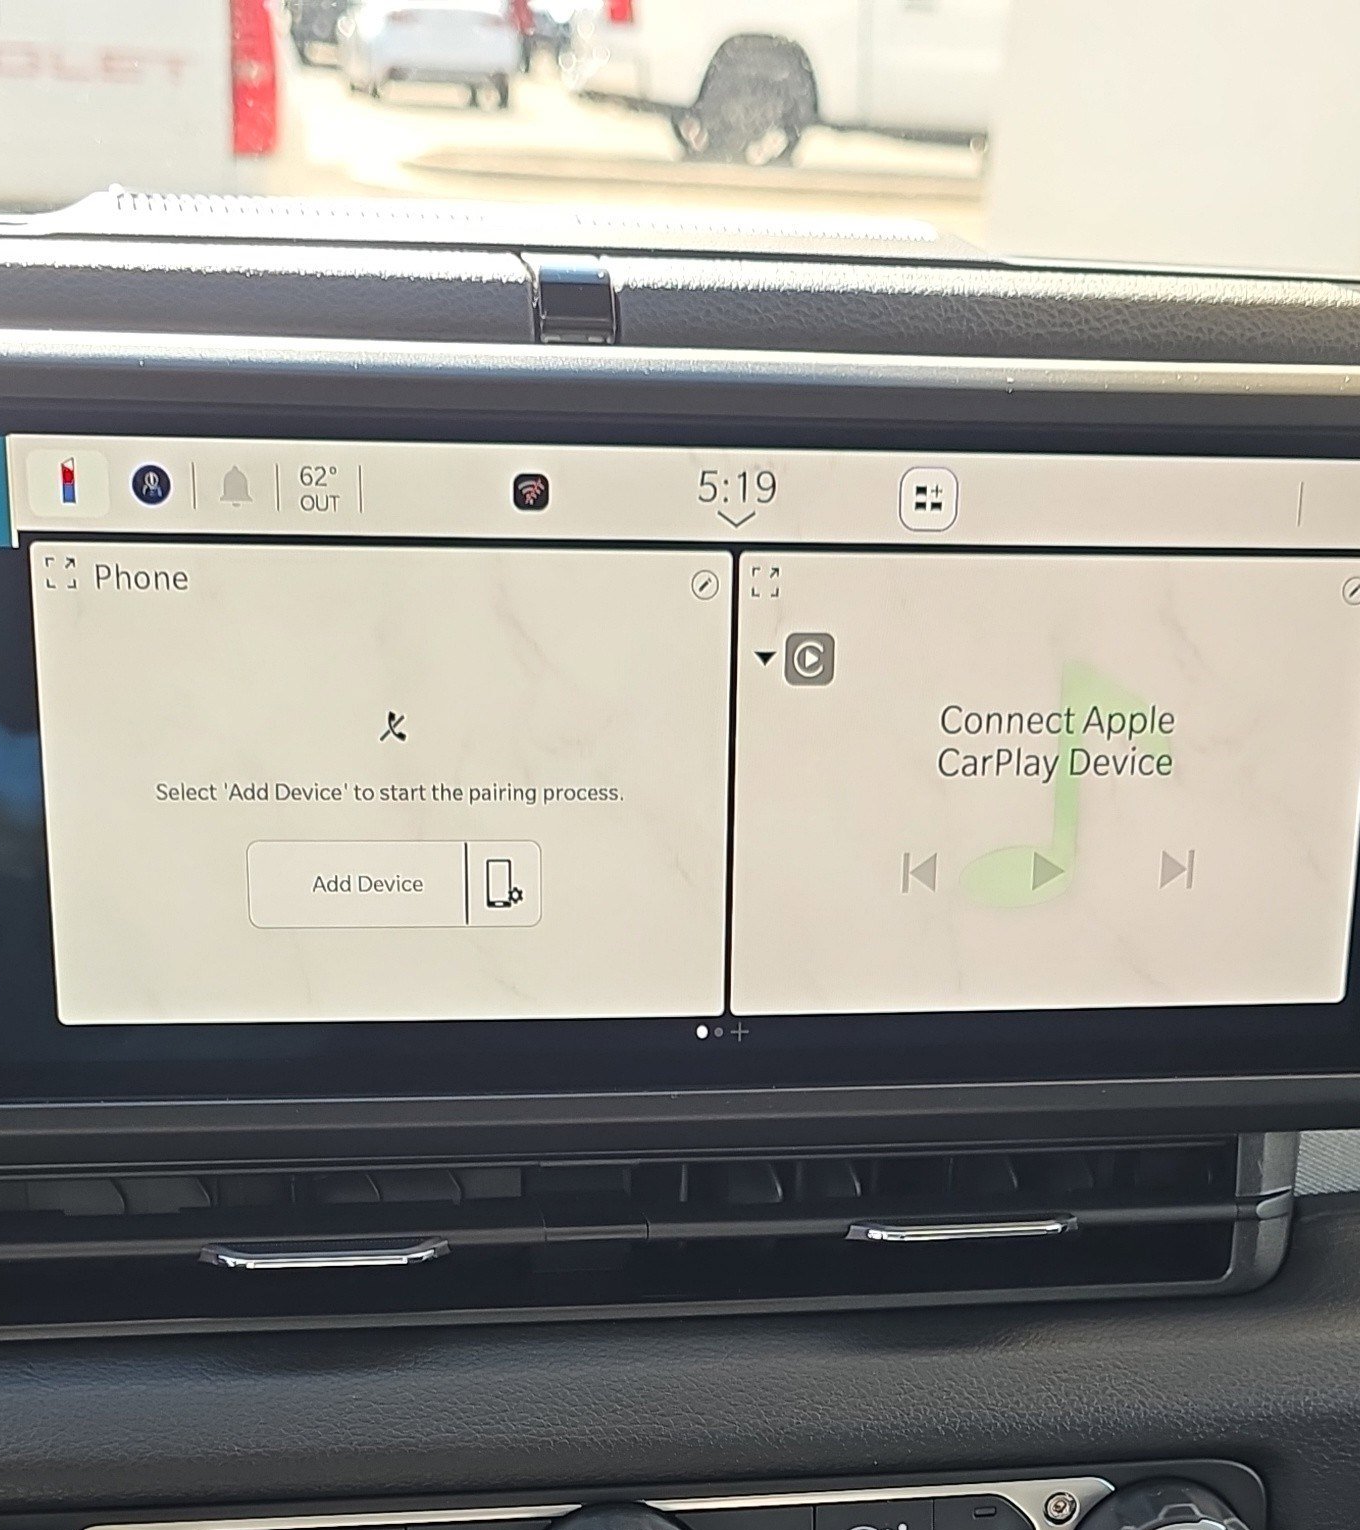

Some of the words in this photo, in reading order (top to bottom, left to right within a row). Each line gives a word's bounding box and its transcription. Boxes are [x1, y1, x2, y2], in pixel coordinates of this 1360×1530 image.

[299, 465, 339, 488] 62°
[697, 469, 778, 506] 5:19
[299, 495, 341, 513] OUT
[94, 563, 190, 591] Phone
[940, 704, 1076, 735] Connect
[1082, 704, 1176, 741] Apple
[938, 747, 1060, 784] CarPlay
[1069, 746, 1174, 776] Device
[155, 782, 218, 802] Select
[353, 783, 375, 802] to
[379, 783, 426, 802] start
[431, 782, 464, 802] the
[468, 783, 537, 806] pairing
[542, 787, 625, 806] process.
[312, 874, 352, 894] Add
[357, 874, 424, 894] Device
